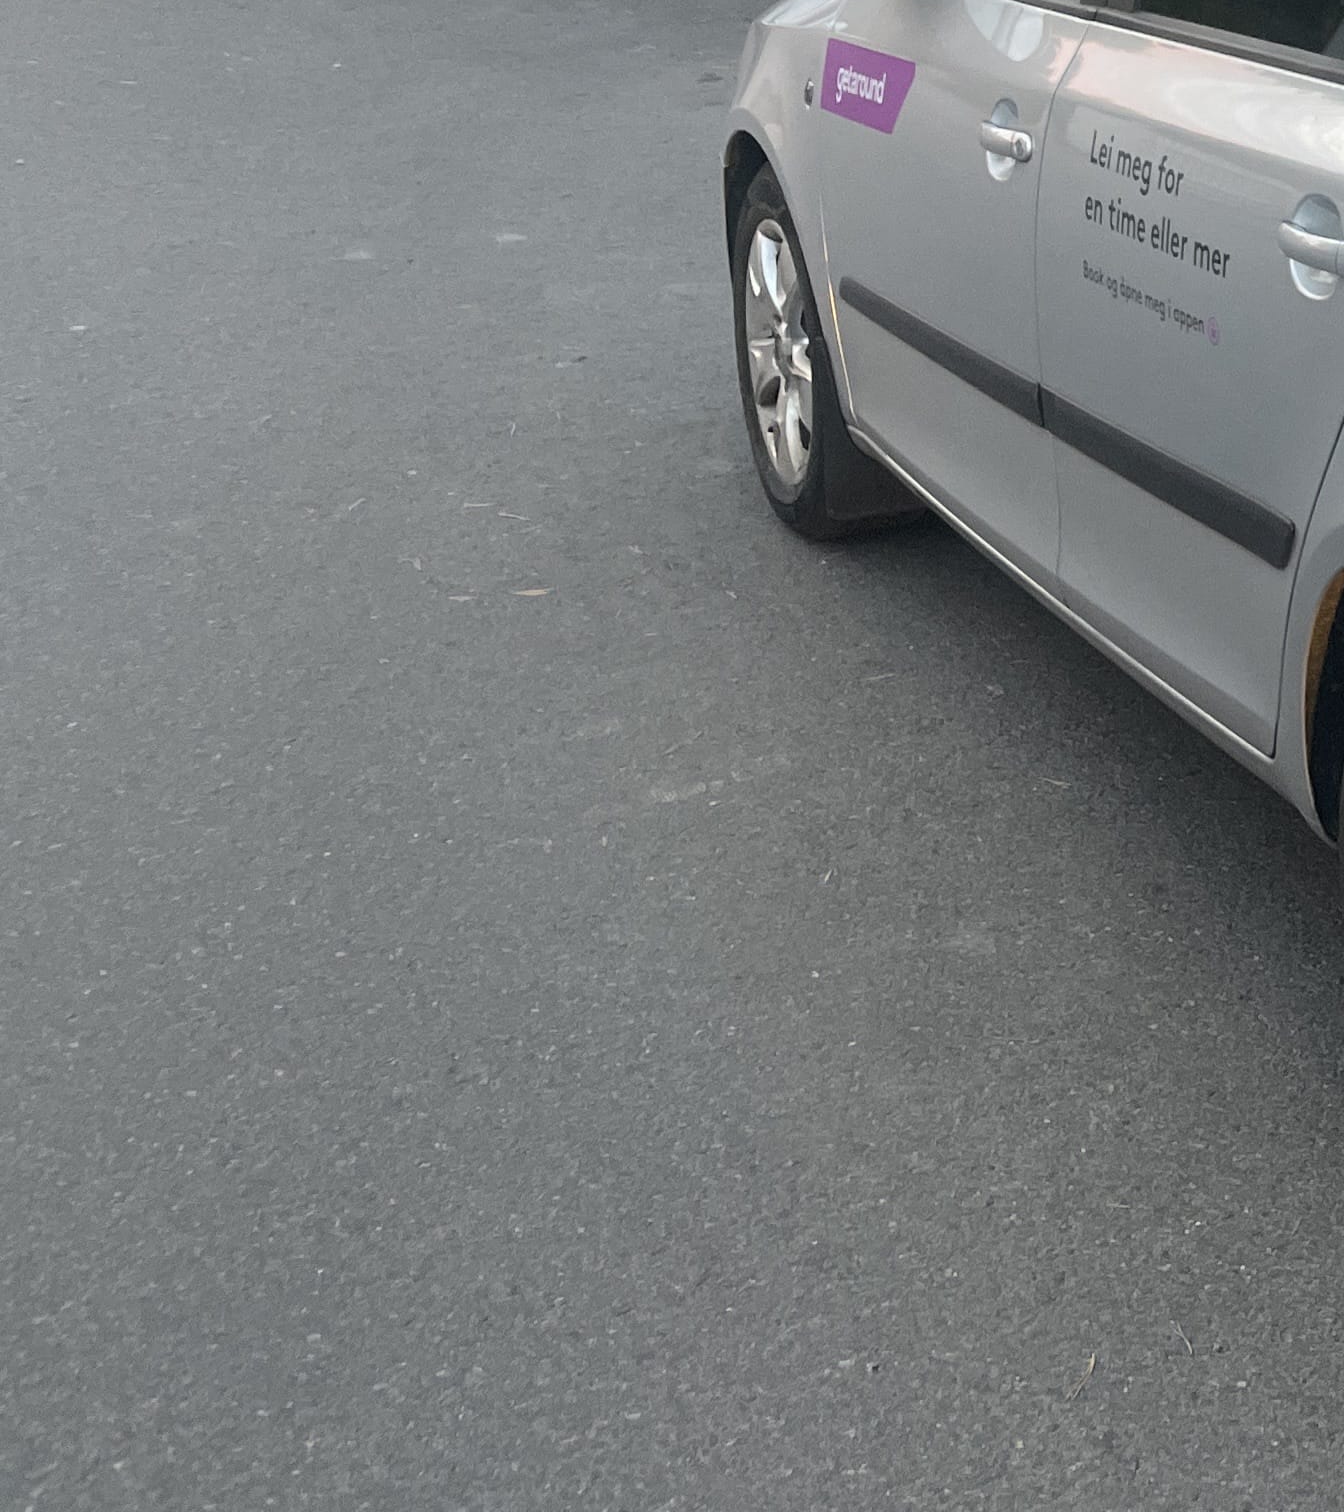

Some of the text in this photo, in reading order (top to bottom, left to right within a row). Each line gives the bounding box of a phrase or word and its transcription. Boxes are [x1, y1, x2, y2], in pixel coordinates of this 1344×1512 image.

[835, 65, 887, 105] getaround
[1090, 129, 1184, 196] Lei meg for
[1084, 196, 1230, 278] en time eller mer
[1106, 276, 1118, 299] og
[1144, 294, 1165, 322] meg
[1173, 308, 1205, 335] appen
